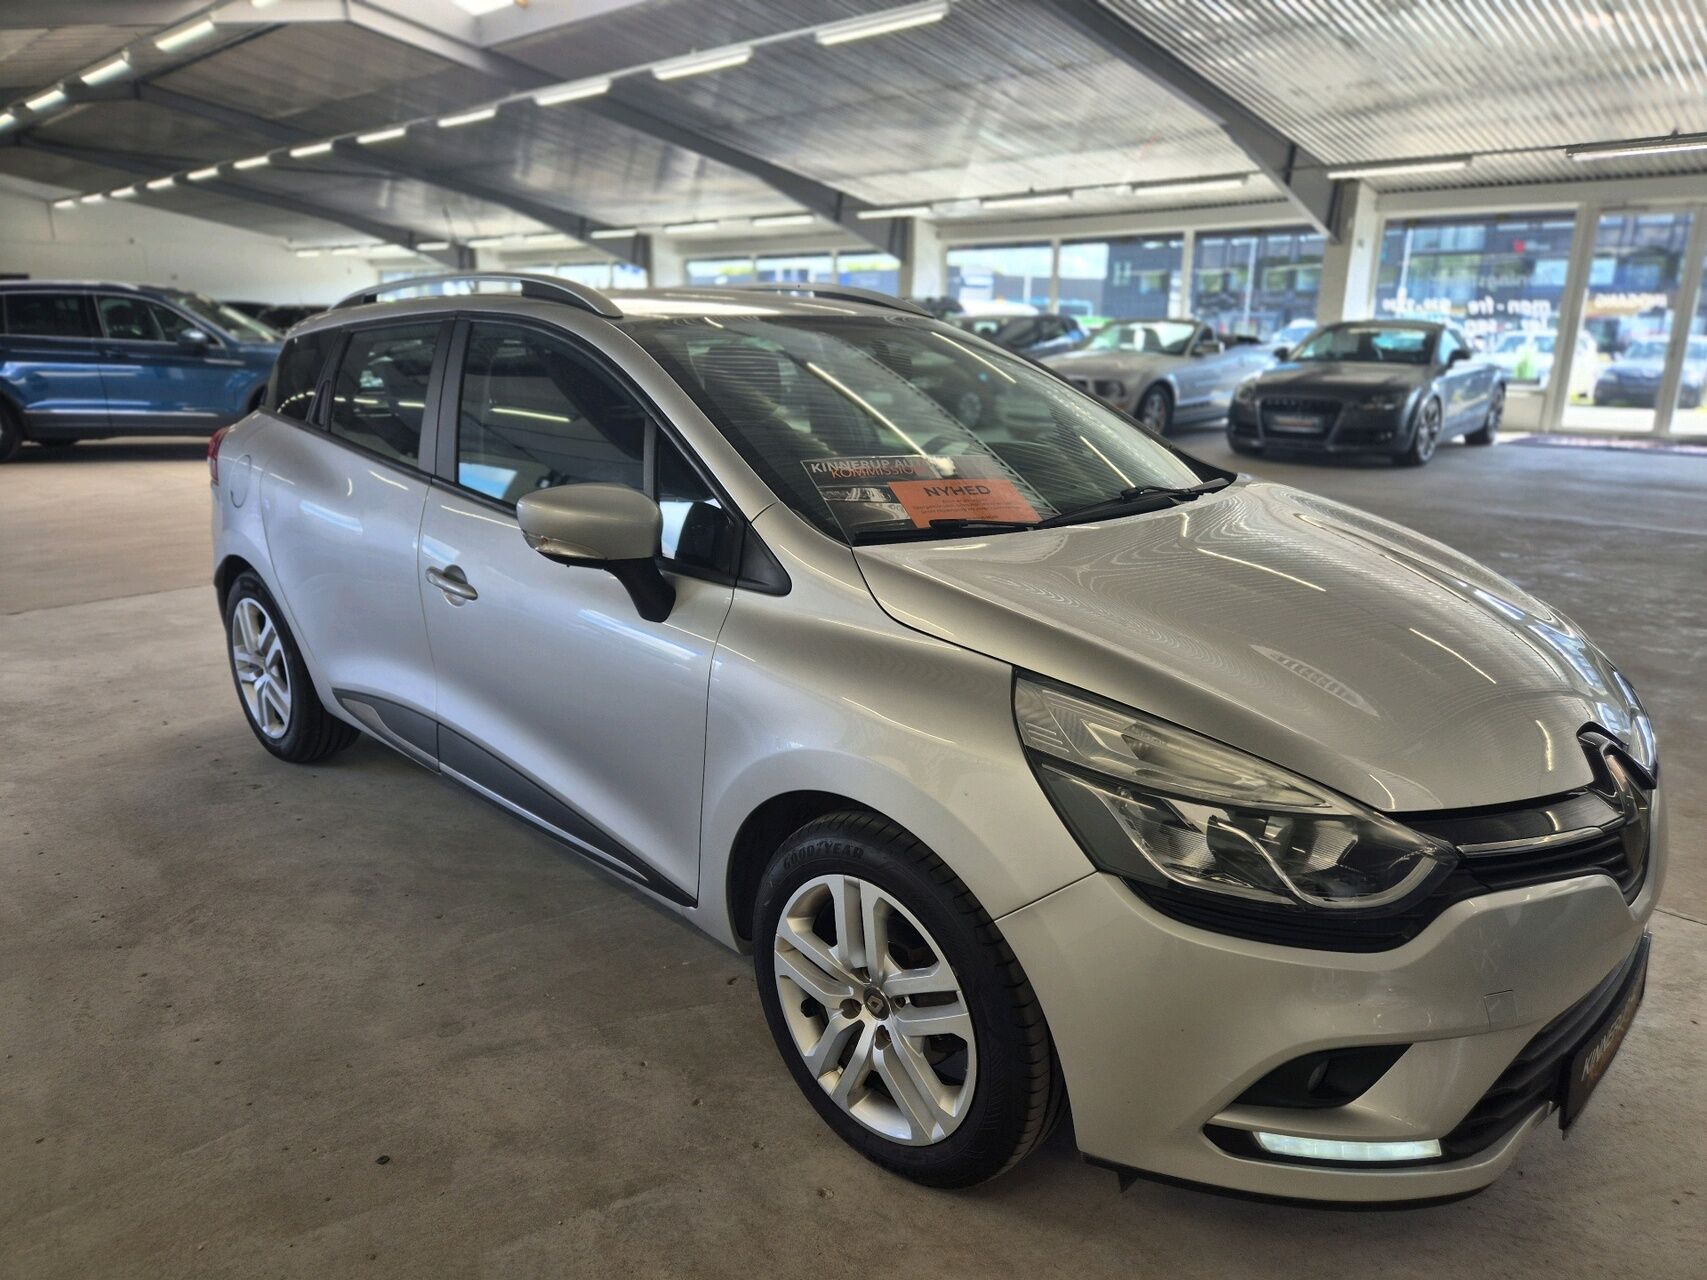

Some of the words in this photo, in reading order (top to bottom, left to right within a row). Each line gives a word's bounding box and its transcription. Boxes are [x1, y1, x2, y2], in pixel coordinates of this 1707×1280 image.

[811, 459, 889, 473] KINNERUP
[923, 485, 991, 497] NYHED
[784, 840, 864, 869] GOODYEAR
